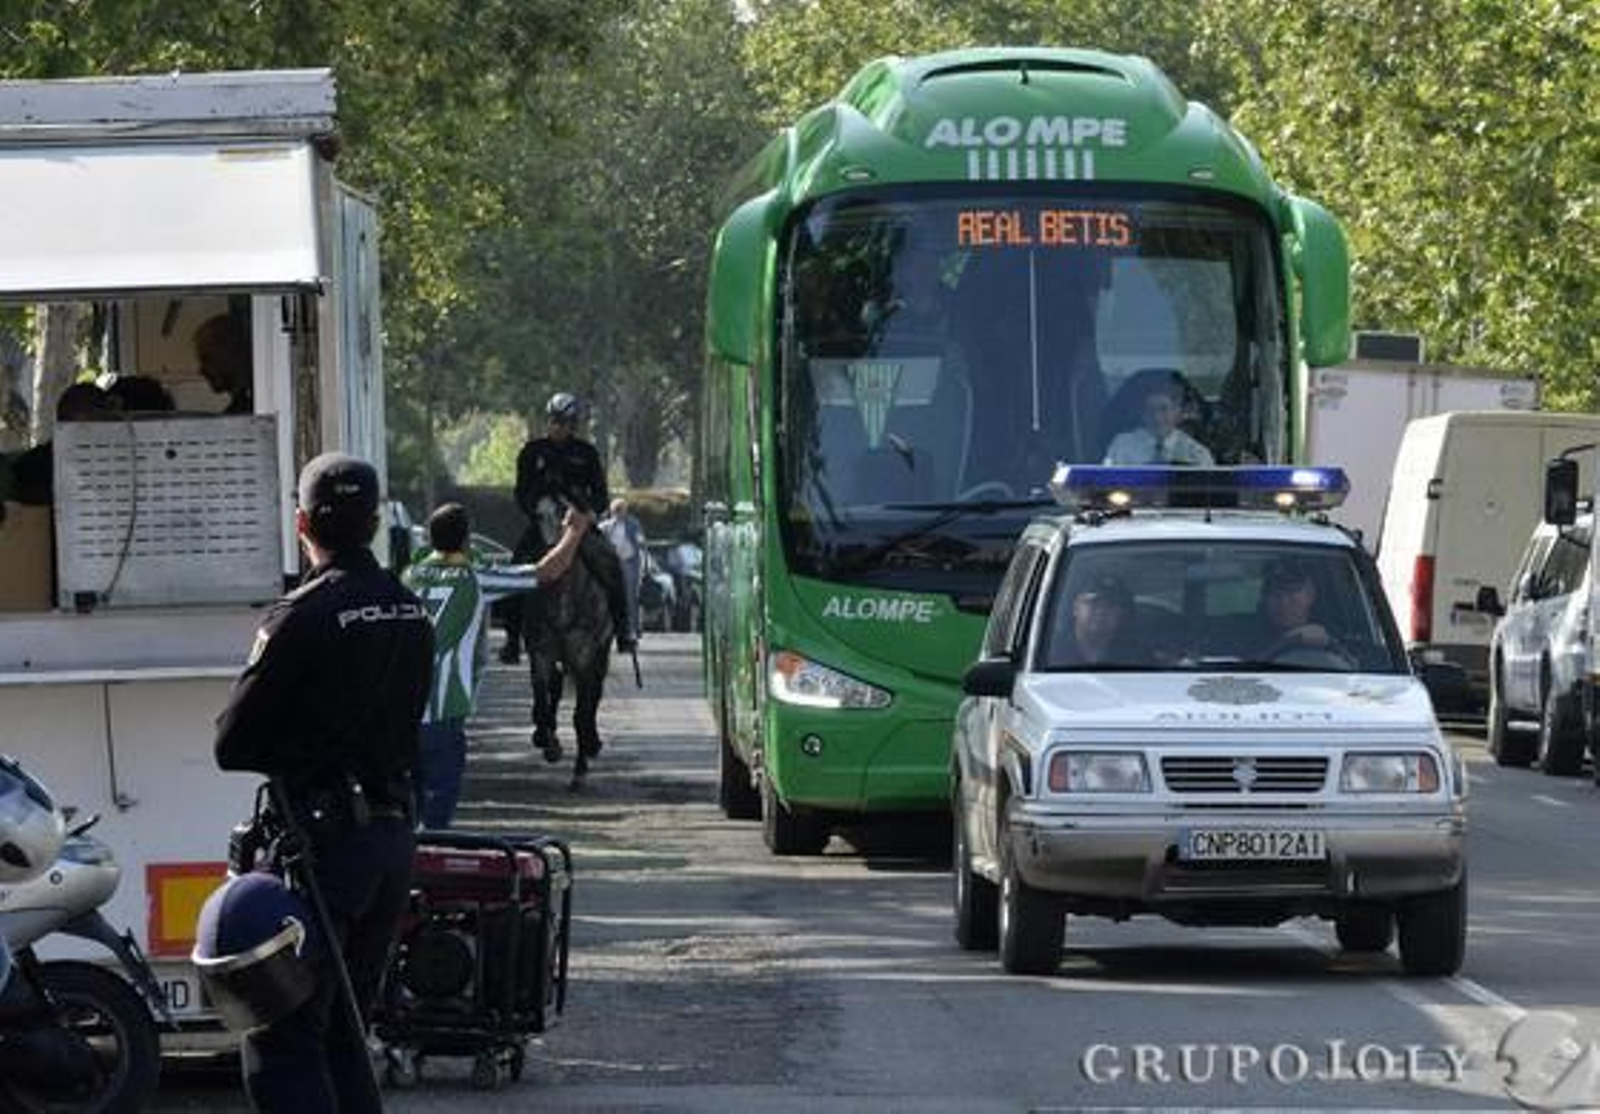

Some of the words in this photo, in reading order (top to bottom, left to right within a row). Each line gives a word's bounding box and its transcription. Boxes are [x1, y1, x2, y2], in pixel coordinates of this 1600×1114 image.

[925, 116, 1127, 147] ALOMPE
[958, 210, 1031, 245] REAL
[1040, 210, 1130, 246] BETIS
[822, 597, 934, 622] ALOMPE
